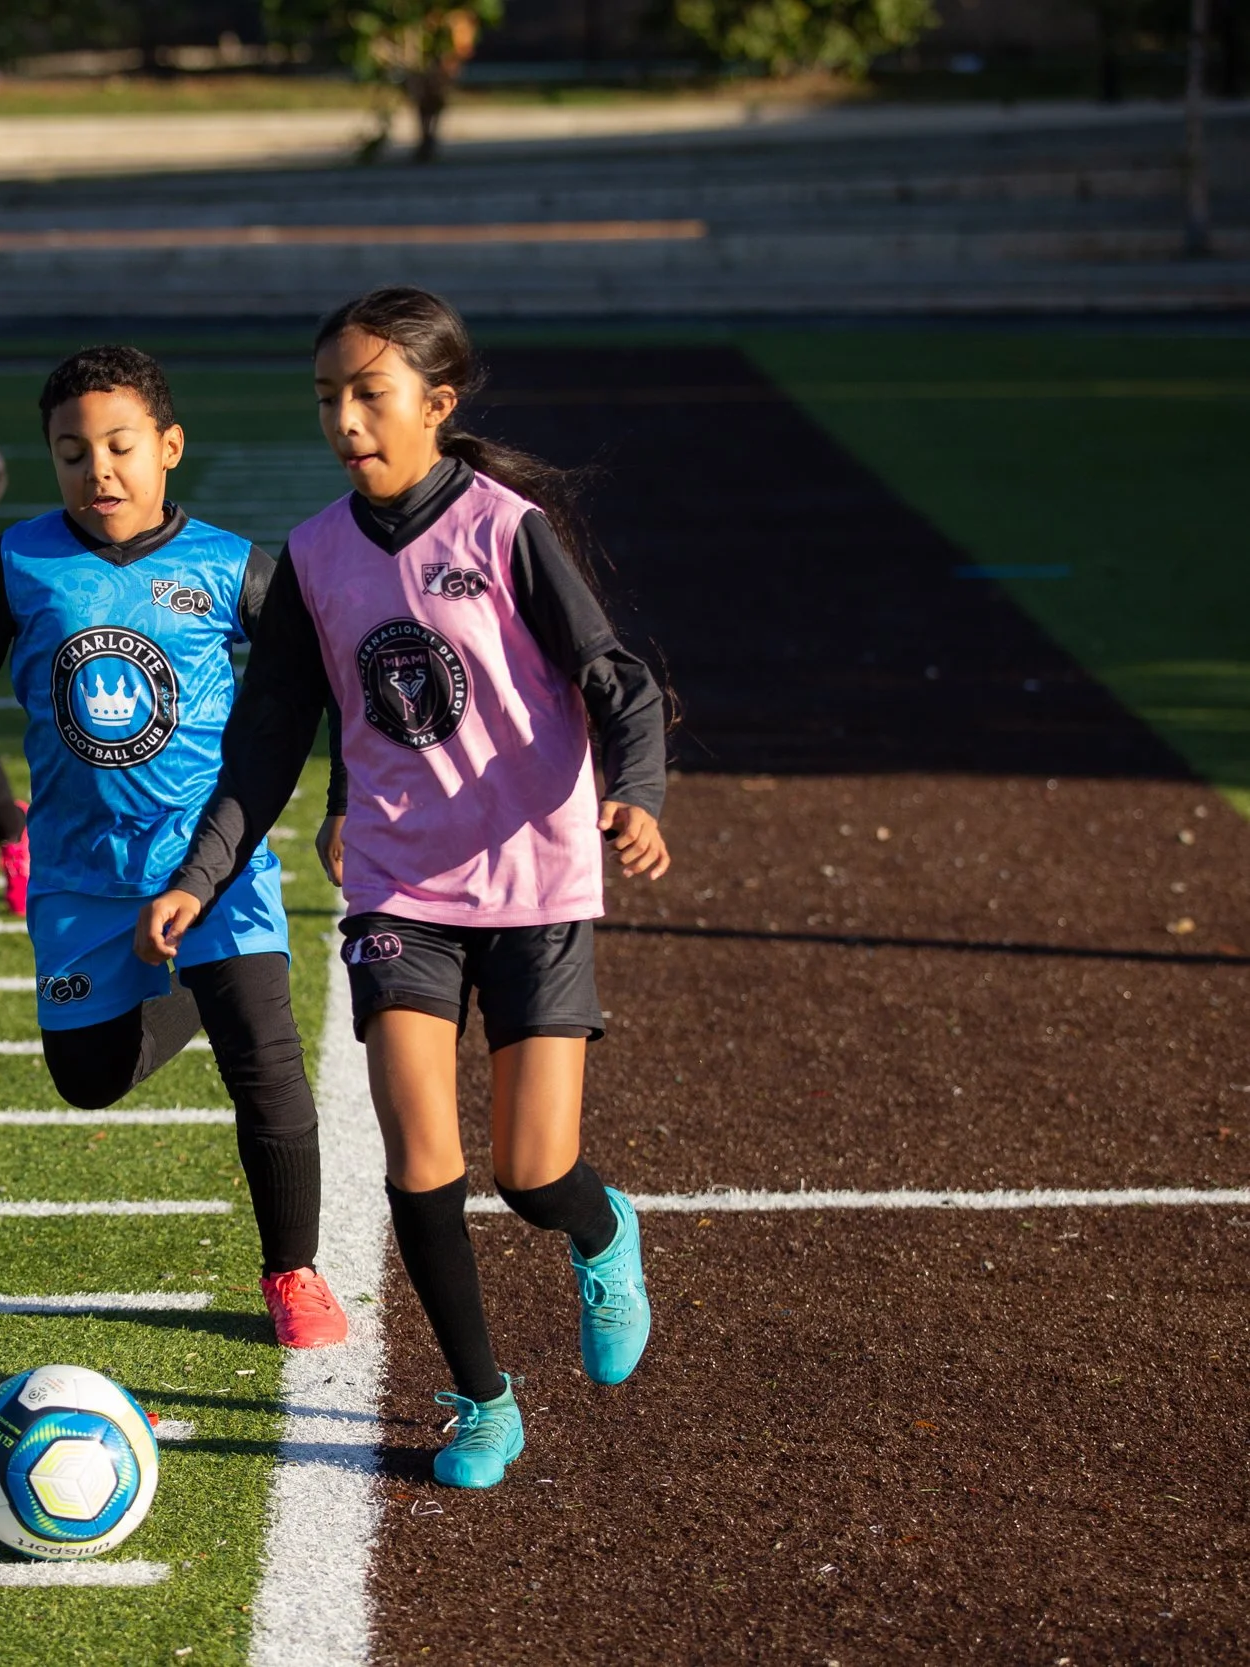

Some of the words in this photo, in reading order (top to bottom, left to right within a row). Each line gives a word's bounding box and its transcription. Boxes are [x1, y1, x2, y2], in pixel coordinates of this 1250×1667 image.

[441, 569, 489, 600] GO
[170, 588, 213, 616] GO
[61, 634, 164, 675] CHARLOTTE
[382, 654, 427, 668] MIAMI
[439, 645, 454, 661] DE
[64, 724, 130, 760] FOOTBALL
[133, 726, 164, 755] CLUB
[359, 933, 402, 963] GO
[50, 974, 91, 1004] GO
[13, 1537, 110, 1557] uhlsport
